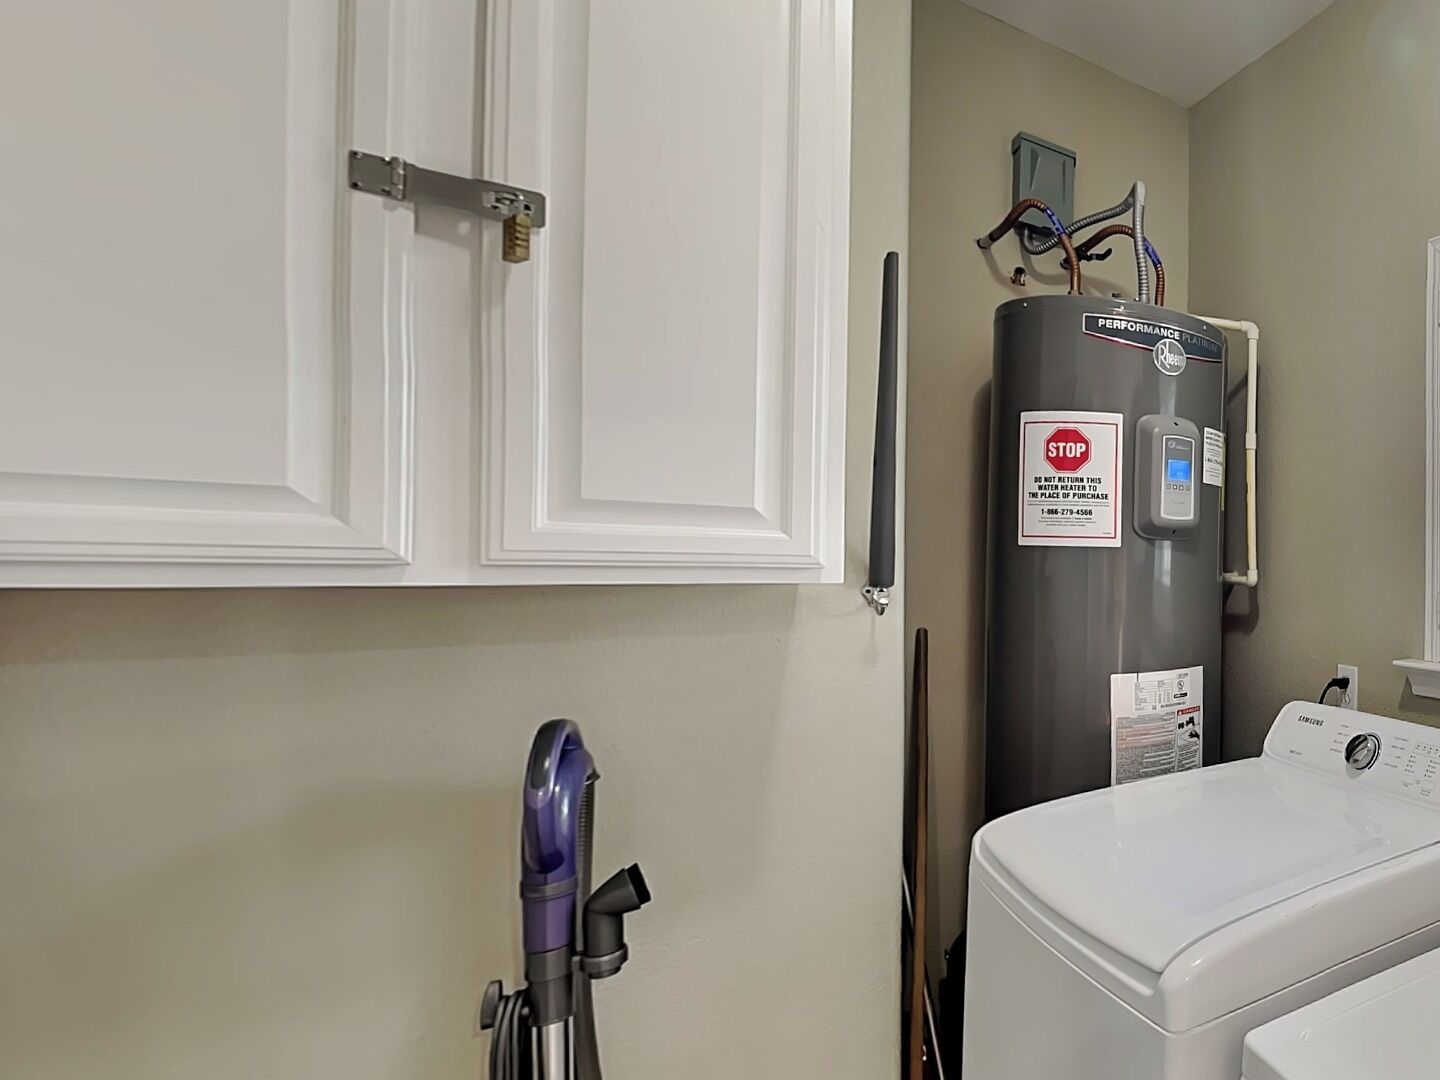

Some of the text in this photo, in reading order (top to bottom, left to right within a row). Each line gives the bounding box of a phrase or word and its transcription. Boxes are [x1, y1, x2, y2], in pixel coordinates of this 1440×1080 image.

[1098, 318, 1180, 340] PERFORMANCE
[1048, 442, 1086, 458] STOP
[1298, 715, 1324, 726] SAMSUNG
